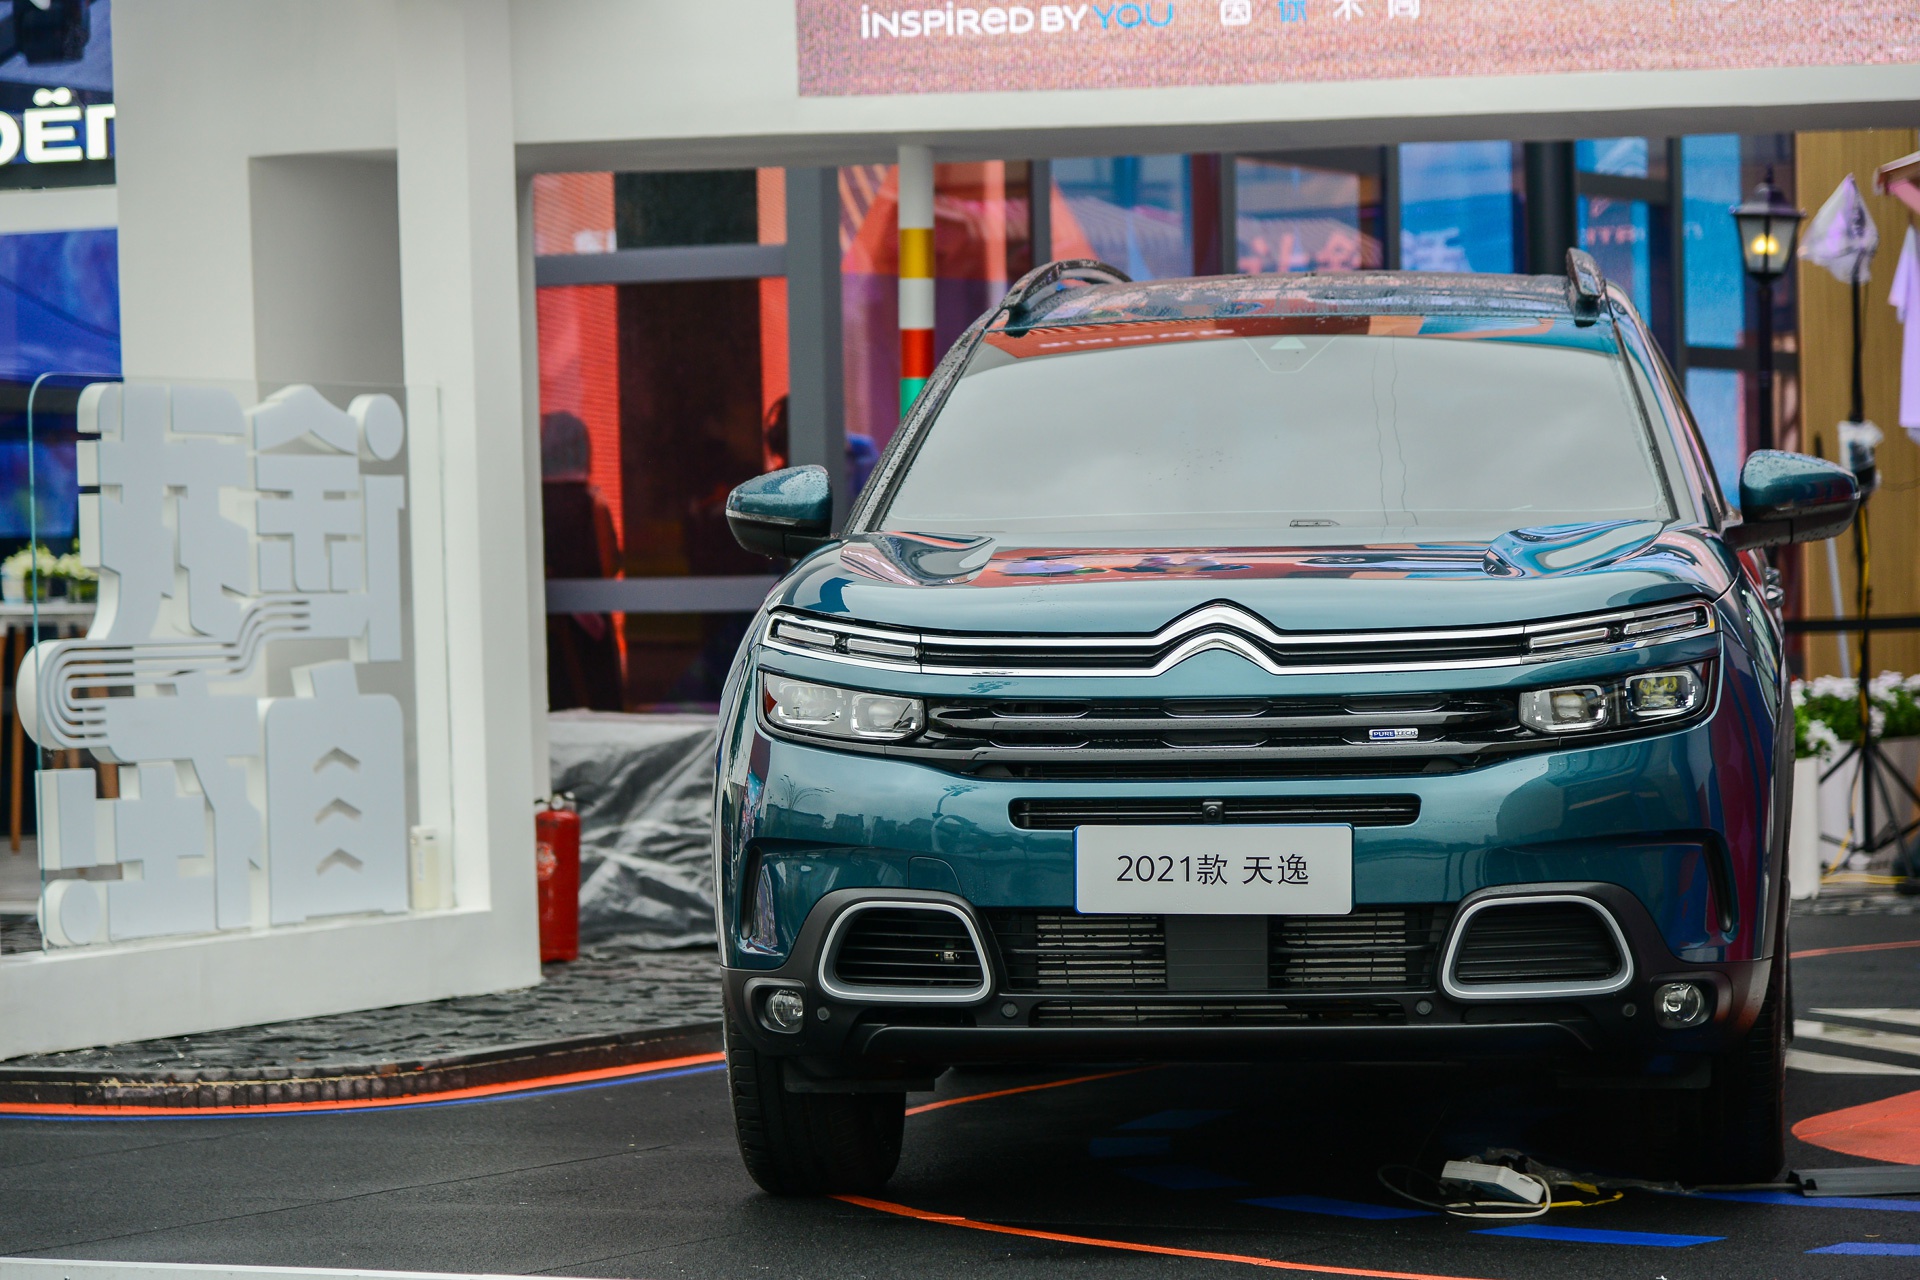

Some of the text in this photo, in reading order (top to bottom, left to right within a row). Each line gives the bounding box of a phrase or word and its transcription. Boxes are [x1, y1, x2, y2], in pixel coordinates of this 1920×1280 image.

[1040, 4, 1088, 32] BY
[1092, 2, 1173, 29] YOU
[1116, 853, 1310, 886] 2021款 天逸
